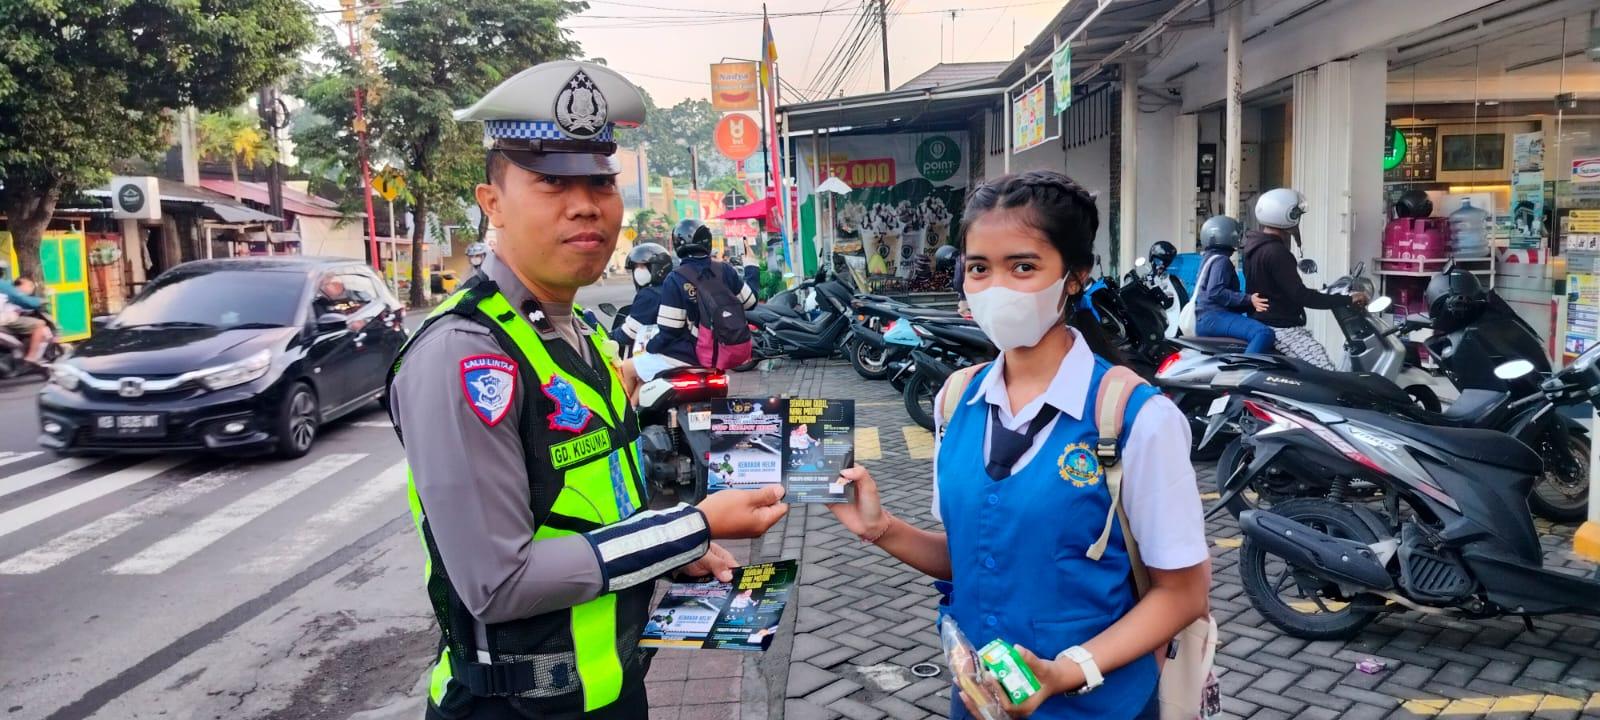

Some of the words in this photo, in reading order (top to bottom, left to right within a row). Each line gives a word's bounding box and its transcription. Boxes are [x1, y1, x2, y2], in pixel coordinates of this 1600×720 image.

[464, 358, 486, 369] LALU
[487, 359, 514, 371] LINTAS
[554, 446, 571, 463] GD.
[572, 433, 607, 458] KUSUMA
